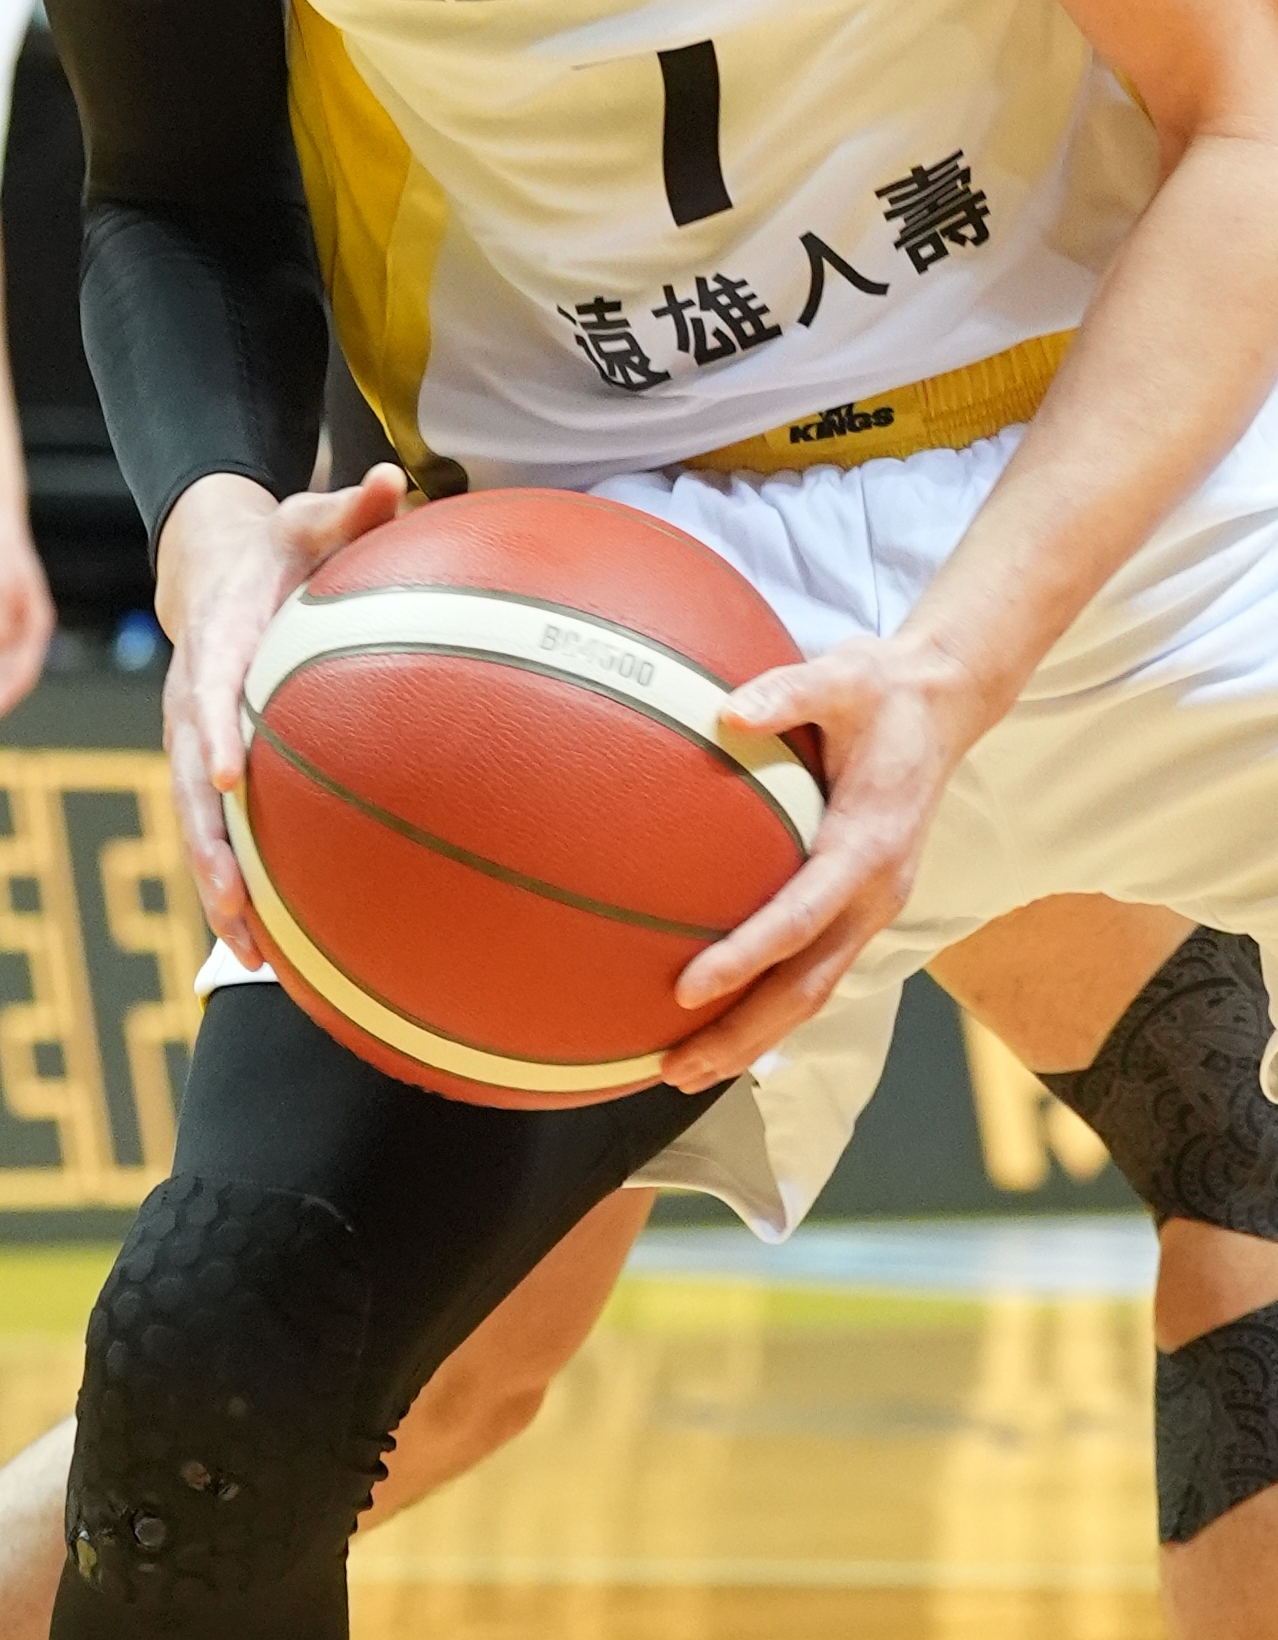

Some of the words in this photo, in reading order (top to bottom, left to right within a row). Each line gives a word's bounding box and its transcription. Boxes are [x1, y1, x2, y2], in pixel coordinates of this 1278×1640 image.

[656, 39, 734, 227] 1
[557, 148, 992, 392] 遠雄人壽
